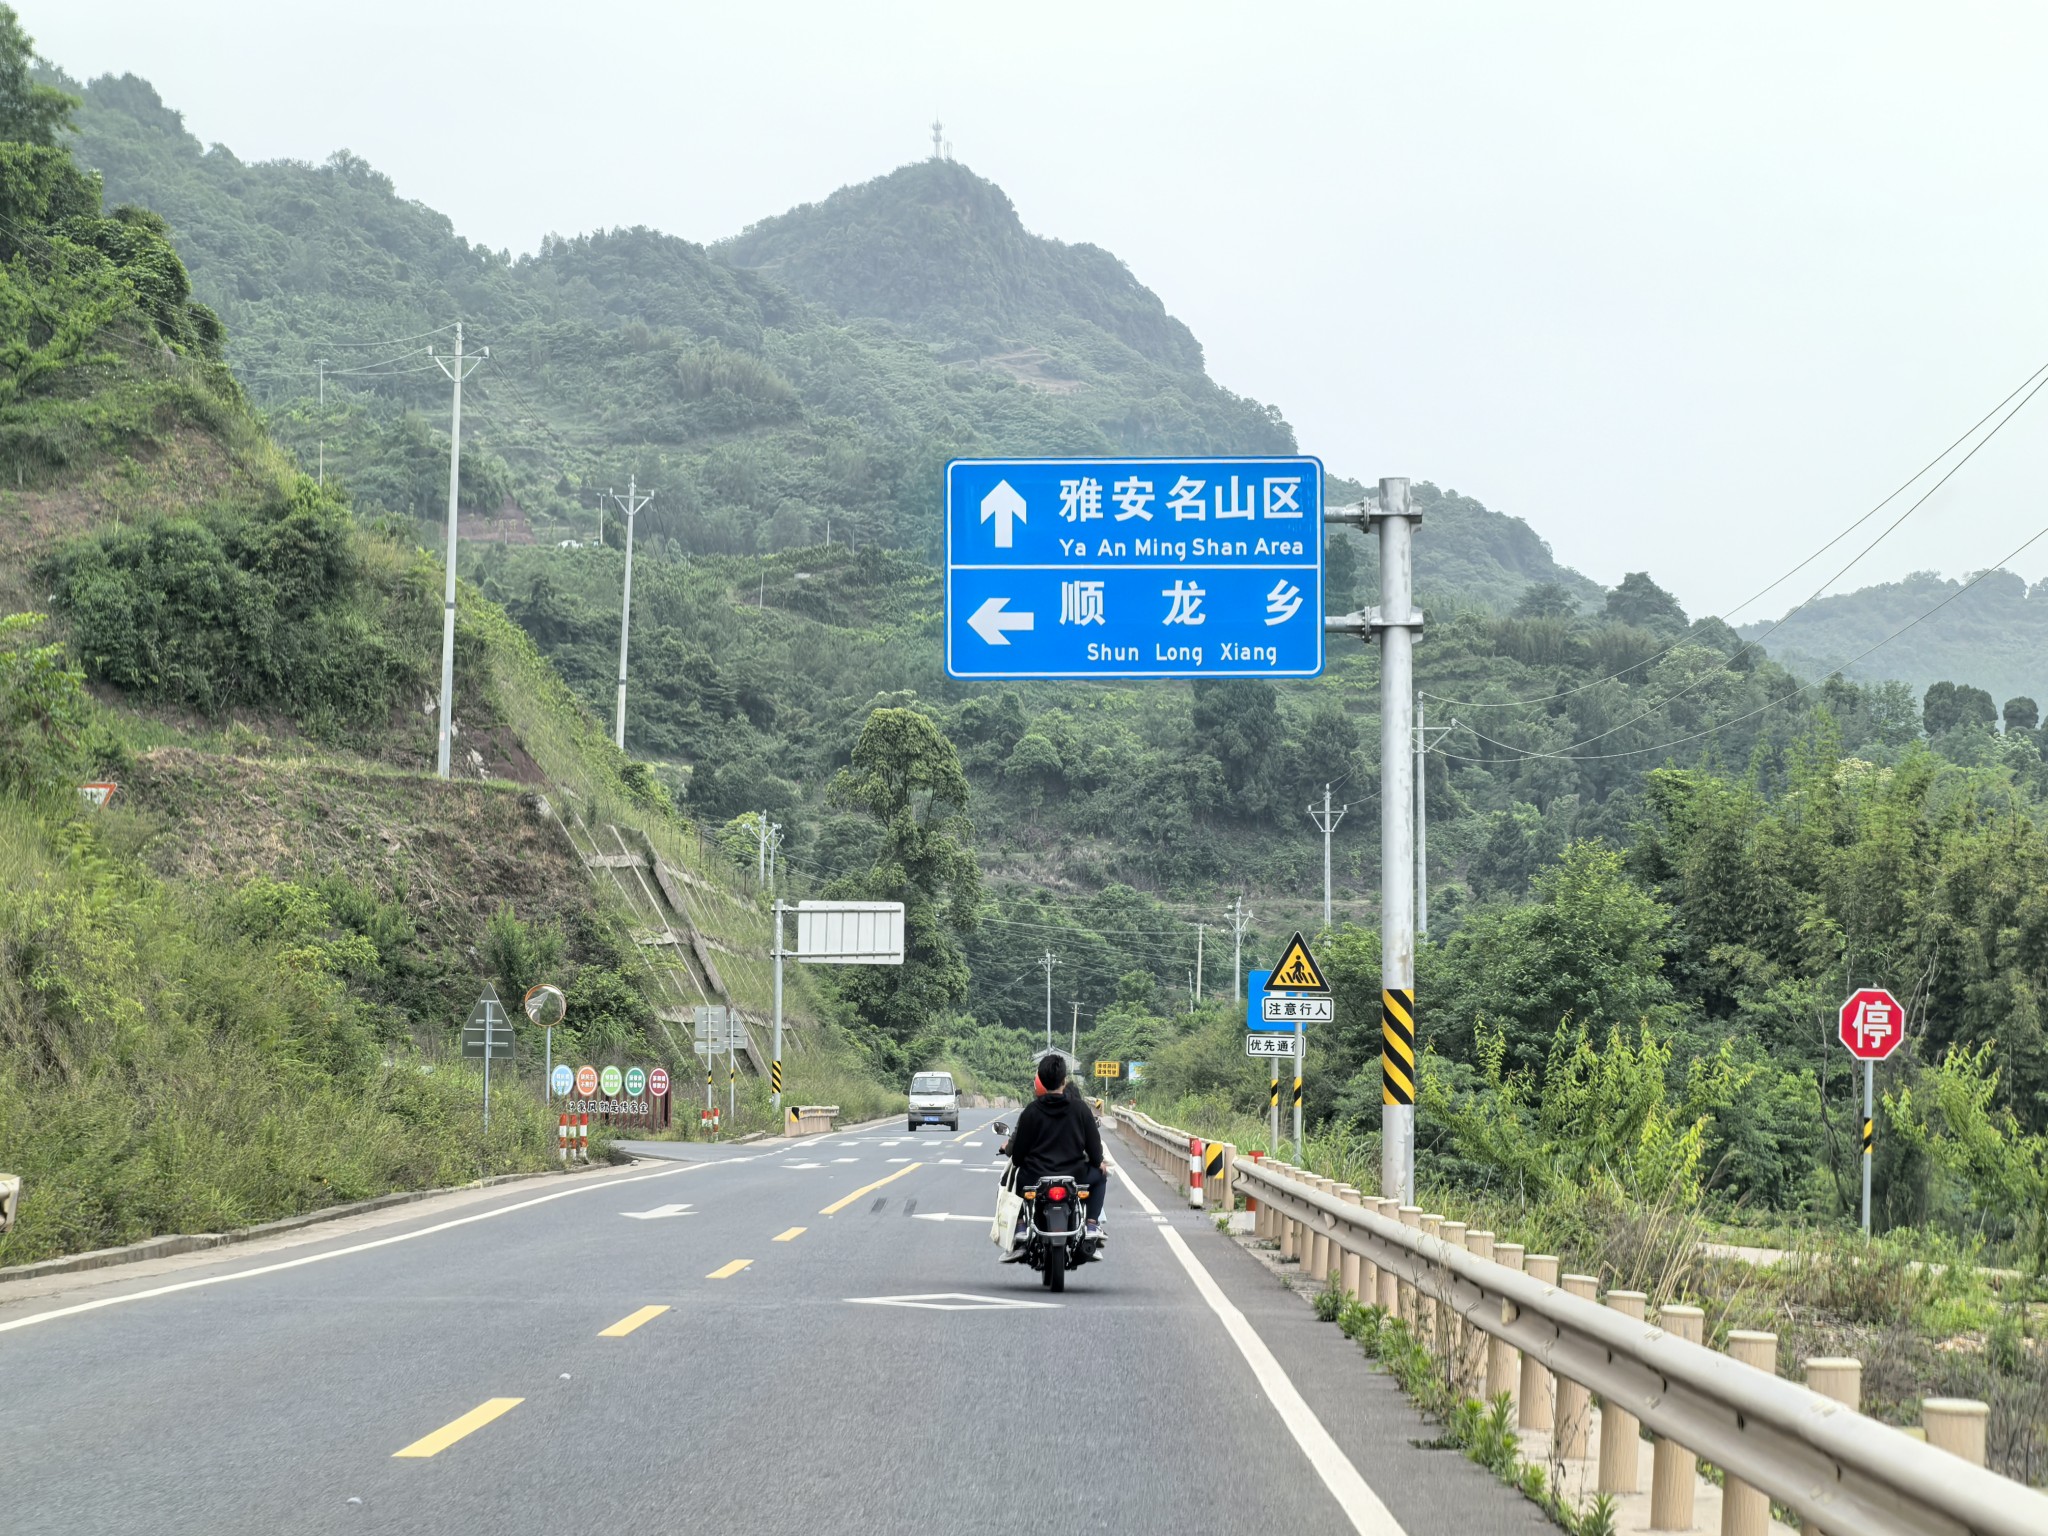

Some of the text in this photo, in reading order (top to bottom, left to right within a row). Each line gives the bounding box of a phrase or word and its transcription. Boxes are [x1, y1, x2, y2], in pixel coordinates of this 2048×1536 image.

[1059, 474, 1304, 523] 雅安名山区
[1059, 537, 1304, 562] Ya An Ming Shan Area
[1059, 579, 1304, 627] 顺龙乡
[1087, 642, 1278, 667] Shun Long Xiang
[1268, 1002, 1328, 1016] 注意行人
[1852, 1000, 1892, 1049] 停
